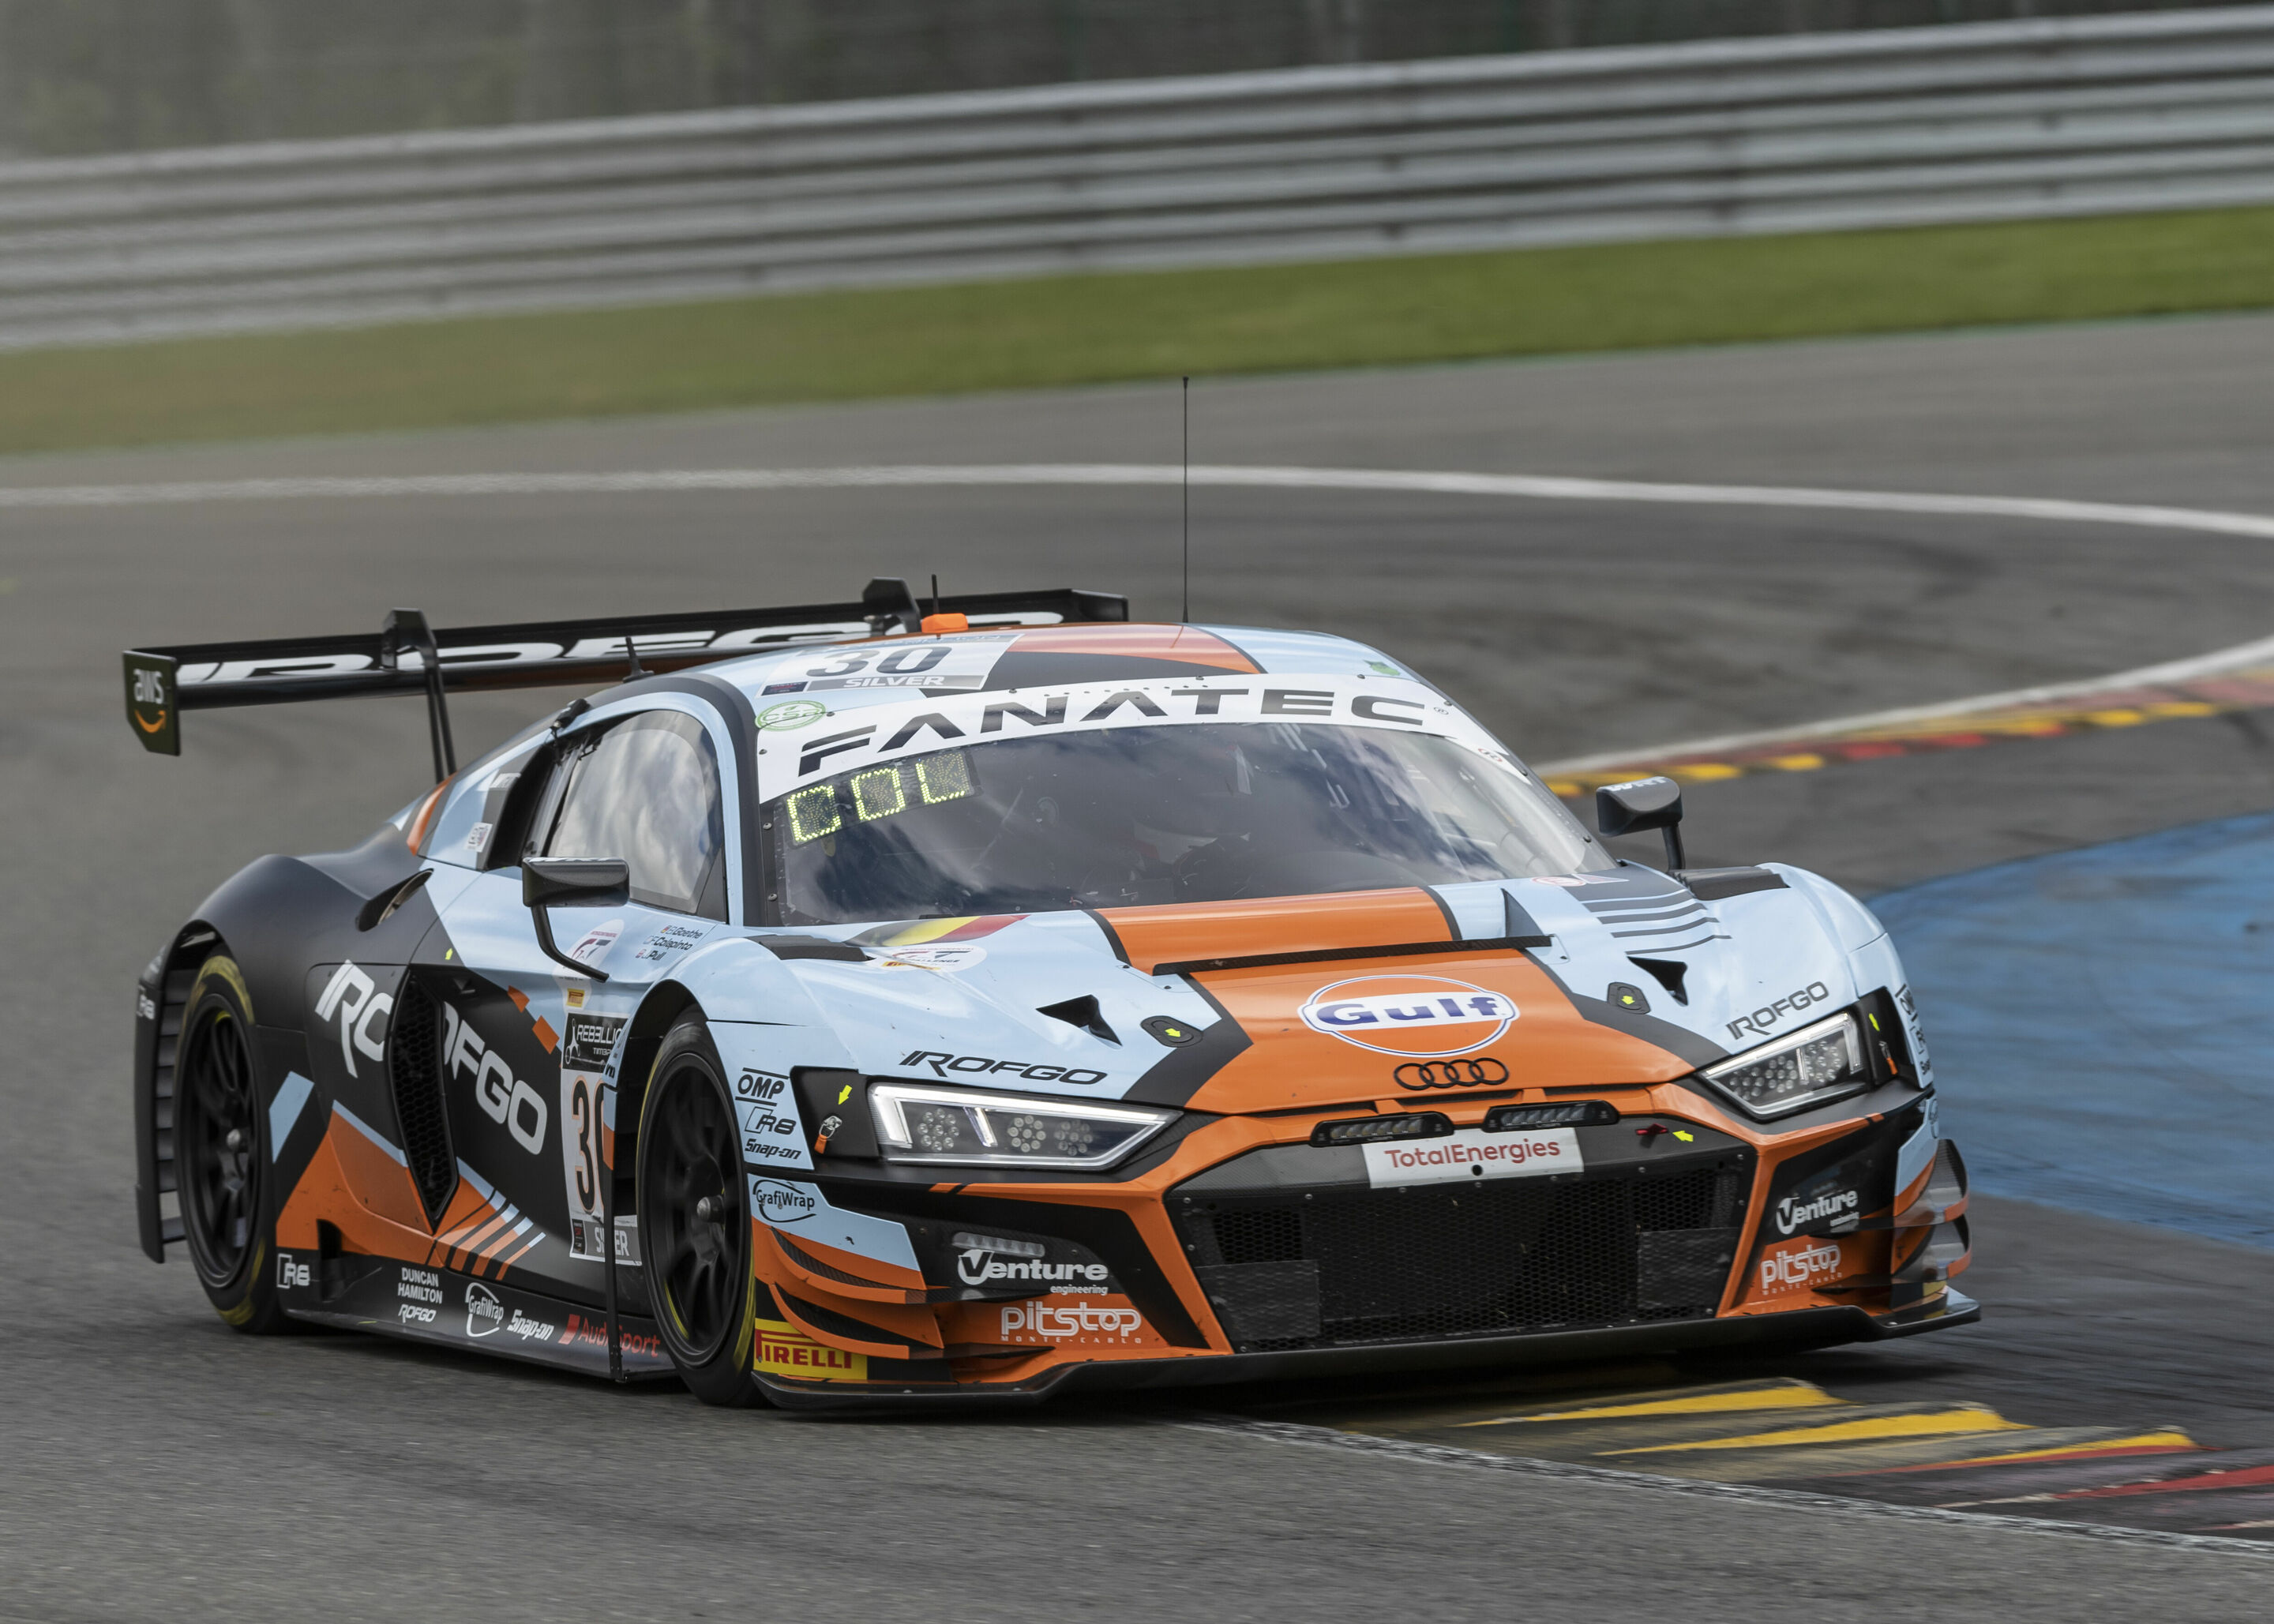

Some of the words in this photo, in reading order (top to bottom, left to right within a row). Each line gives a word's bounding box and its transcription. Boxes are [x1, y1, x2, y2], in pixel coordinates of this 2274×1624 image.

[806, 647, 951, 677] 30
[133, 668, 164, 704] aws
[843, 675, 945, 688] SILVER
[797, 688, 1425, 777] FANATEC
[787, 761, 966, 842] COL
[1316, 996, 1500, 1026] Gulf
[737, 1074, 785, 1100] OMP
[755, 1114, 797, 1135] R8
[745, 1138, 801, 1160] Snap-on
[1384, 1138, 1561, 1168] TotalEnergies
[756, 1189, 815, 1211] GrafiWrap
[1777, 1190, 1858, 1234] Venture
[594, 1226, 630, 1257] SIER
[283, 1262, 310, 1287] R8
[401, 1267, 439, 1287] DUNCAN
[958, 1249, 1109, 1285] Venture
[1762, 1244, 1841, 1289] pitstop
[398, 1282, 443, 1304] HAMILTON
[1049, 1284, 1109, 1296] engineering
[468, 1296, 504, 1326] GrafiWrap
[507, 1309, 554, 1341] Snap-on
[1001, 1301, 1142, 1337] pitstop
[577, 1317, 609, 1347] Aud
[755, 1329, 853, 1369] PIRELLI
